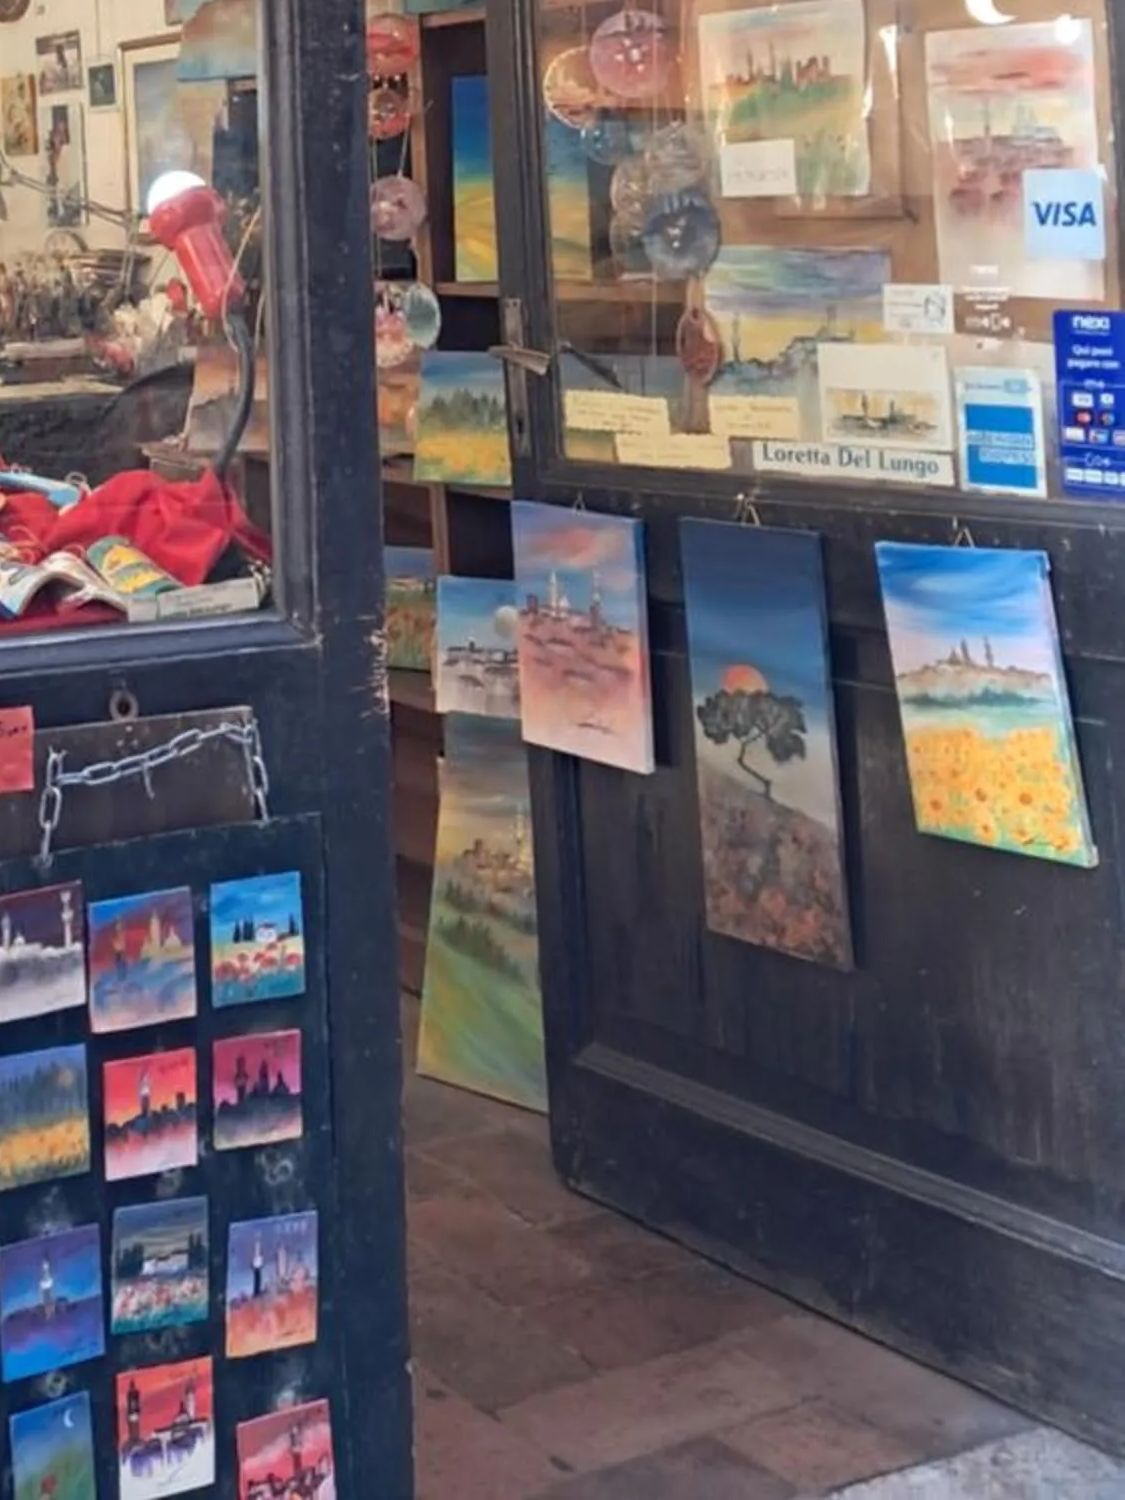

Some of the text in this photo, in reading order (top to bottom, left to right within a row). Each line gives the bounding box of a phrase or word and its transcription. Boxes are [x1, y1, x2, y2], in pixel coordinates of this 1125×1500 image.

[1032, 201, 1097, 227] VISA
[763, 442, 940, 478] Loretta Del Lungo
